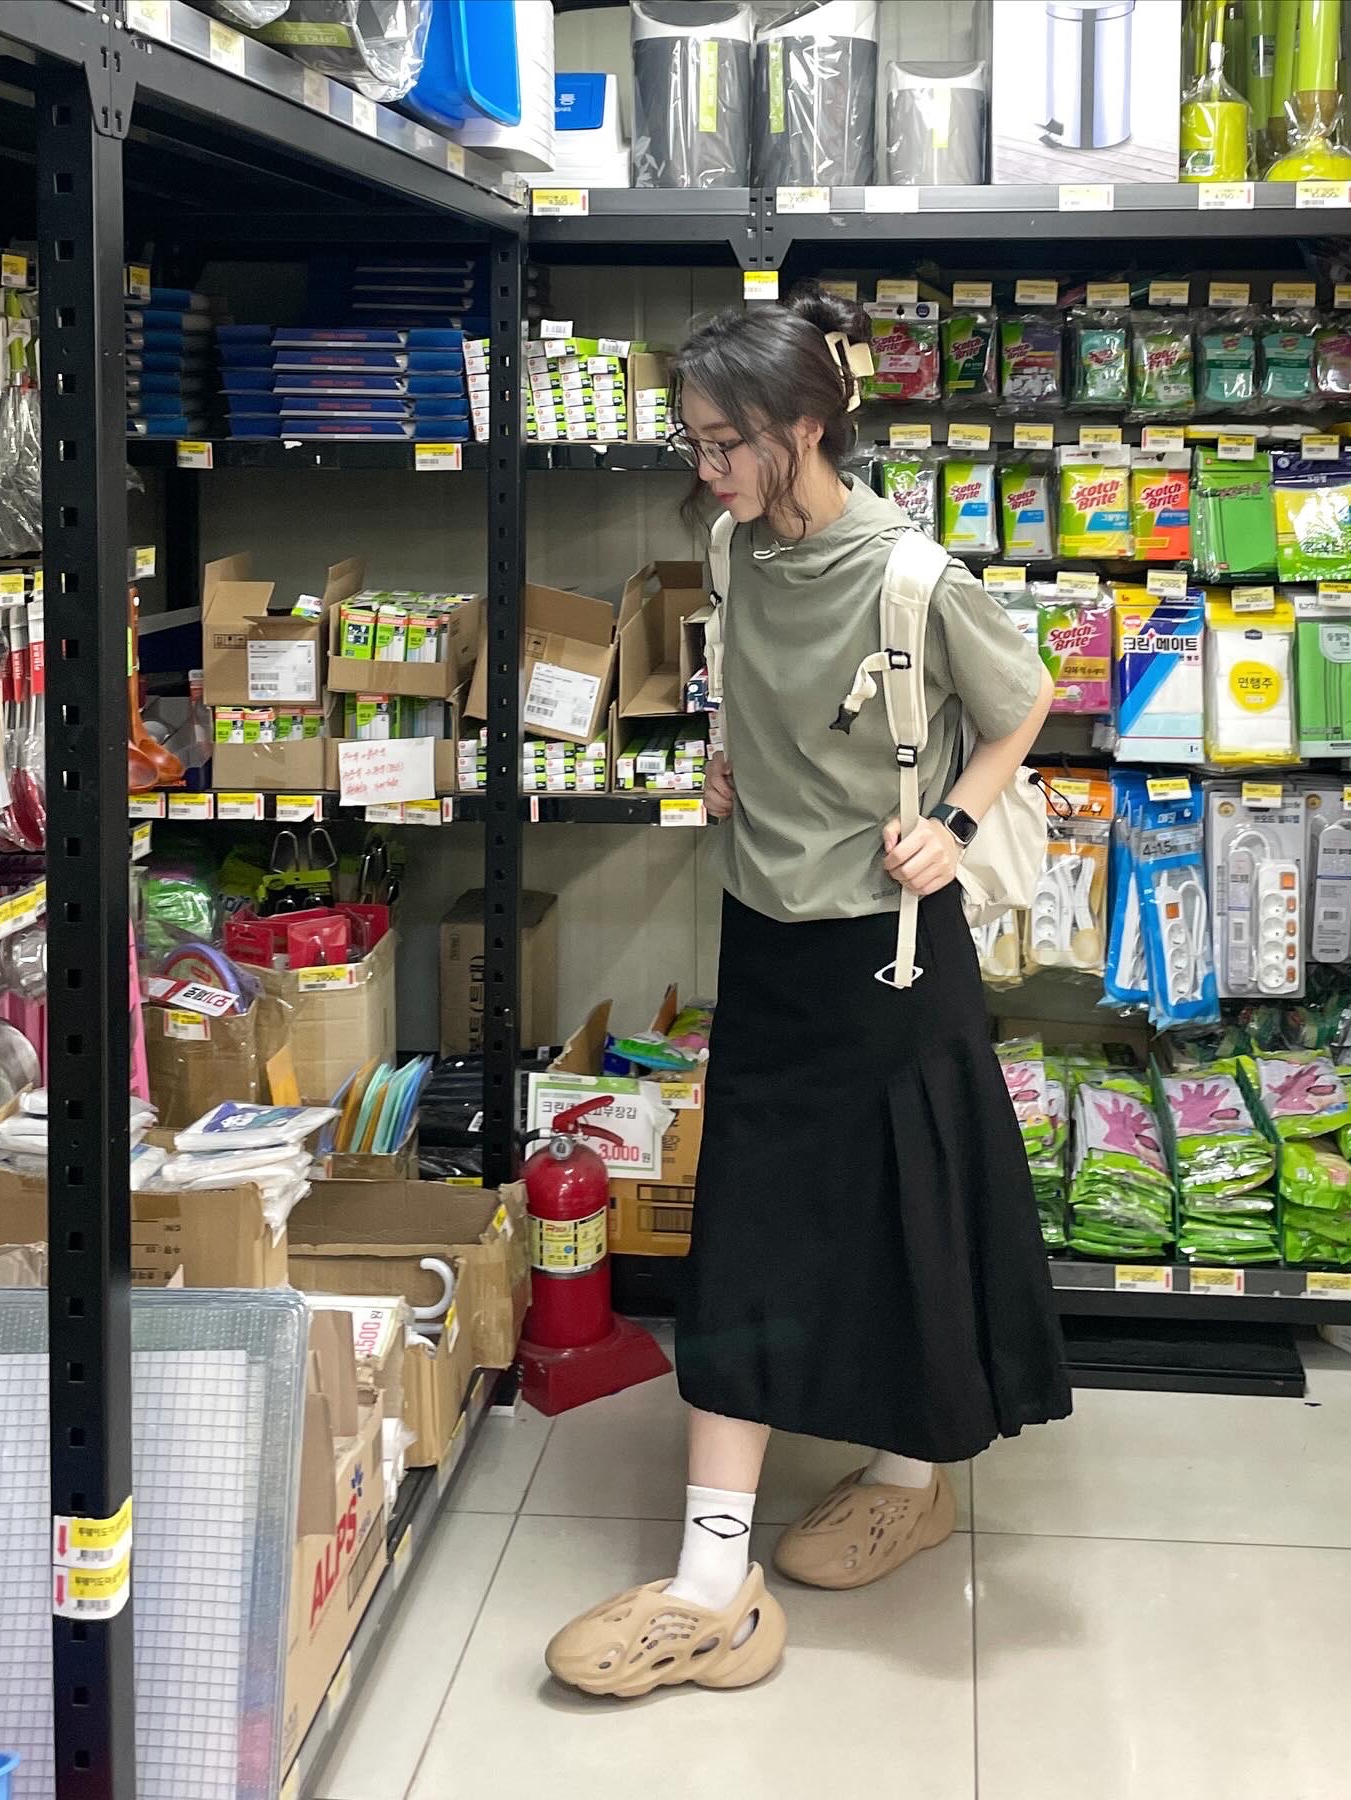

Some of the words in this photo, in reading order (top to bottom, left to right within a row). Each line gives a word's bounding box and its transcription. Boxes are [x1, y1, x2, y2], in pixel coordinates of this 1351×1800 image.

[954, 490, 980, 503] Brite
[1076, 493, 1117, 511] Brite
[1147, 493, 1180, 509] Brite
[1011, 498, 1034, 511] Brite
[1054, 637, 1090, 652] Brite
[1123, 637, 1150, 652] 크린
[1156, 637, 1197, 651] 메이트
[1238, 676, 1273, 689] 면행주
[599, 1144, 640, 1161] 3,000
[309, 1493, 357, 1631] ALPS
